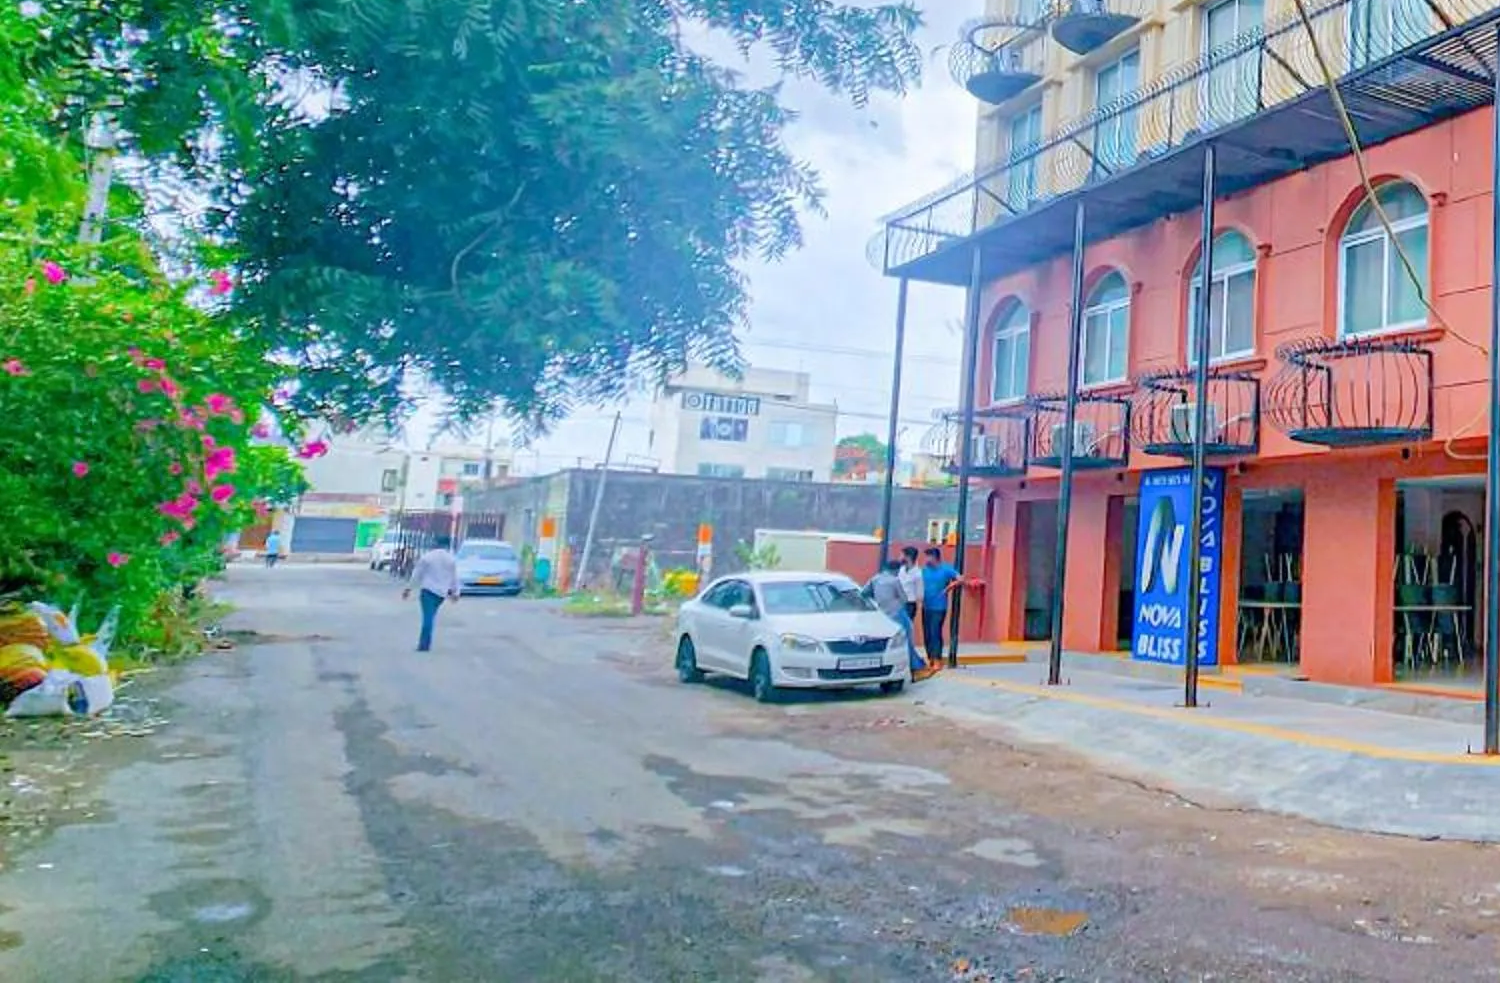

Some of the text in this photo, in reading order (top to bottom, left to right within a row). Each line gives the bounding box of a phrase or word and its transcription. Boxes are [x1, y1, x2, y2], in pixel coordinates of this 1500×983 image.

[1138, 603, 1181, 628] NOVA
[1198, 556, 1213, 658] BLISS
[1137, 634, 1181, 661] BLISS
